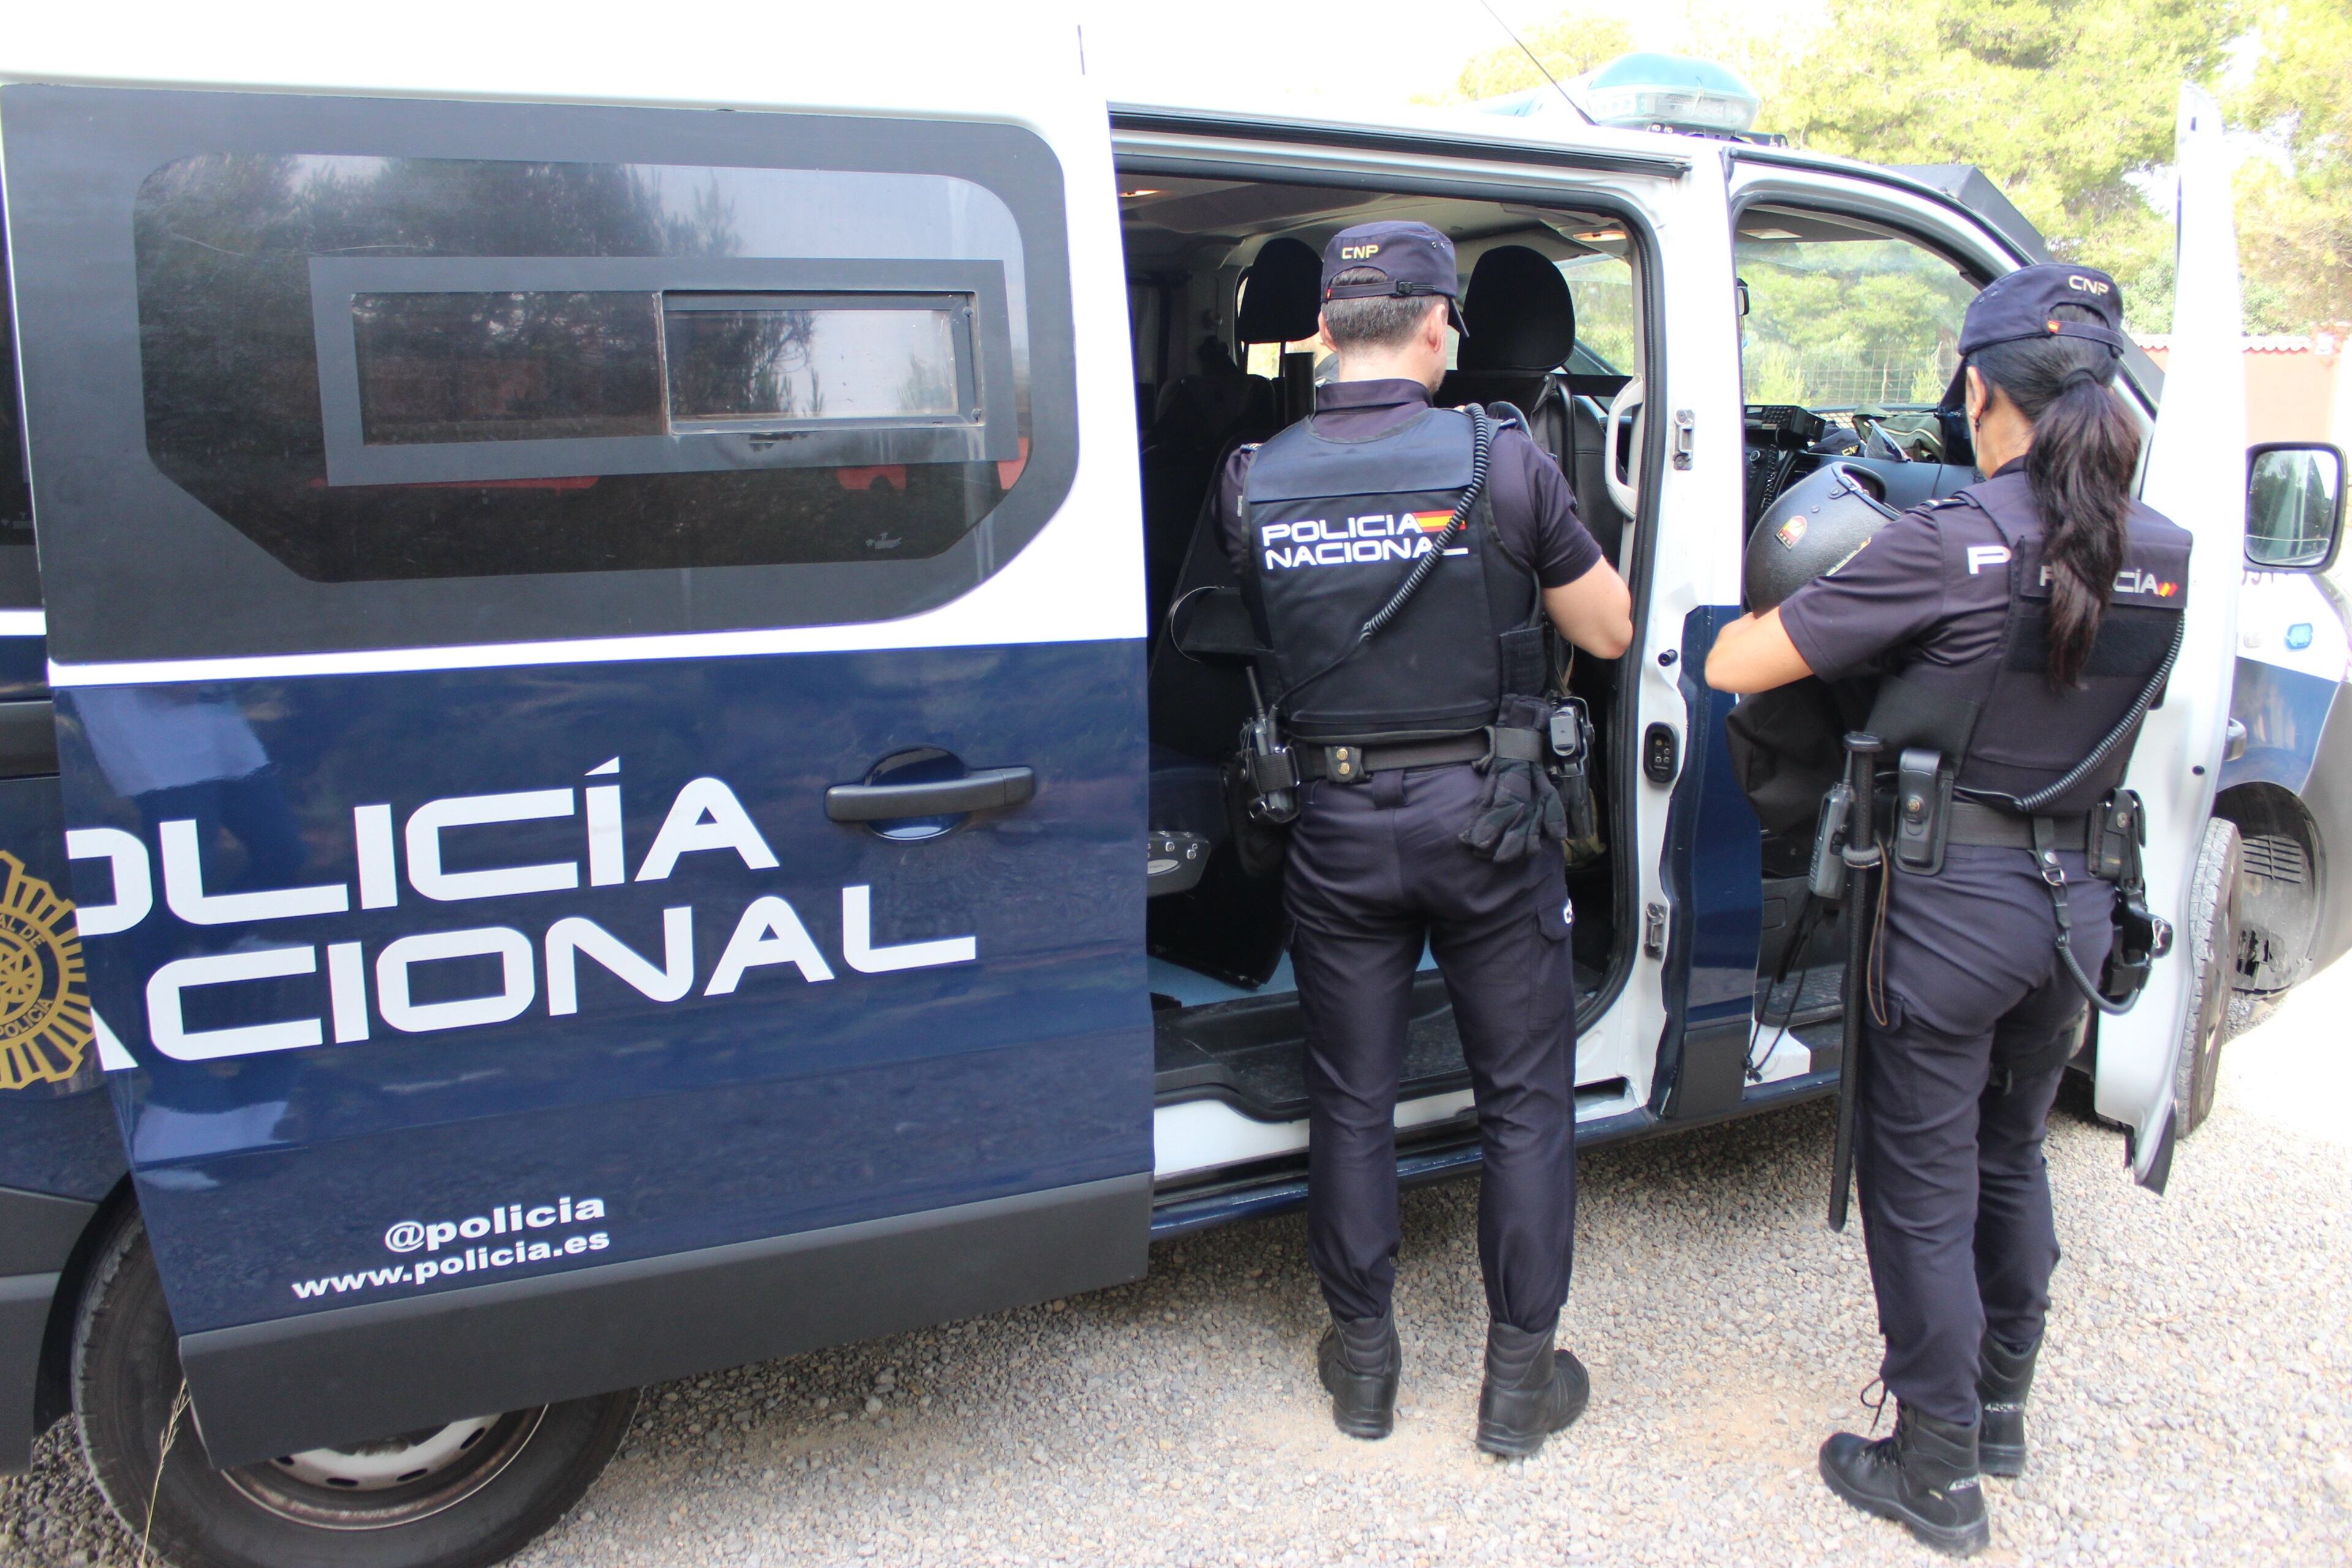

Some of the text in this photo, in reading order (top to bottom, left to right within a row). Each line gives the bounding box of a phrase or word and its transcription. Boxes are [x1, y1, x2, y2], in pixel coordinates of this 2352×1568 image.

[1341, 244, 1379, 260] CNP
[2068, 274, 2110, 296] CNP
[18, 924, 47, 949] DE
[90, 884, 976, 1071] CIONAL
[385, 1196, 605, 1253] @policia
[292, 1232, 610, 1298] www.policia.es
